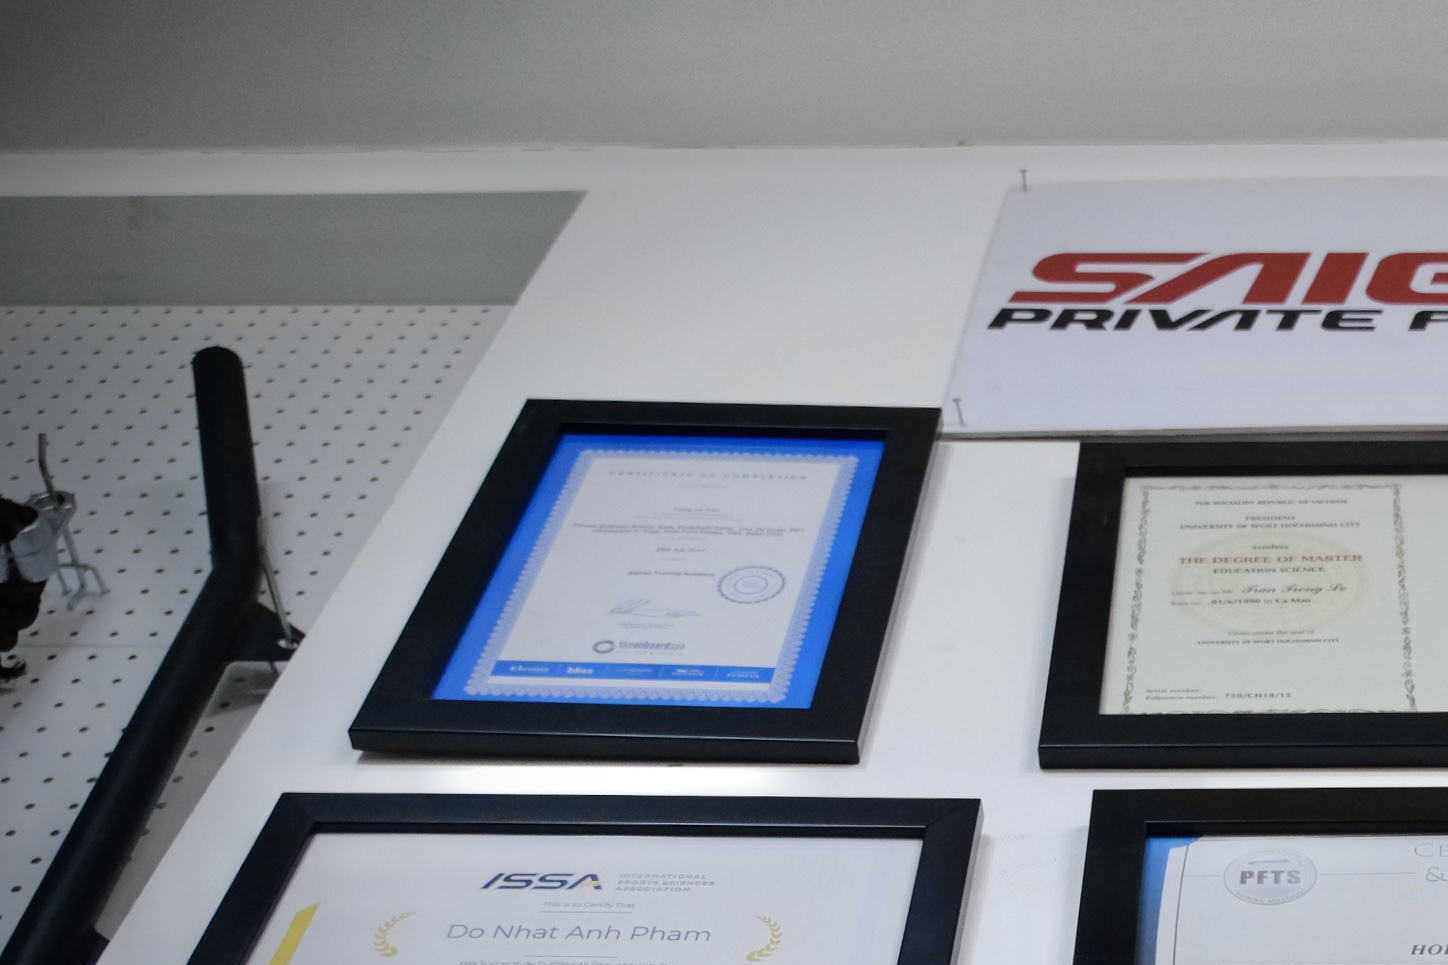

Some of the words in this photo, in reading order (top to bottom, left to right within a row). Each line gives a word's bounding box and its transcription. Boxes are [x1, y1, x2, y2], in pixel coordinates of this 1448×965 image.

[987, 308, 1382, 332] PRIVATE
[1212, 556, 1272, 564] DEGREE
[1276, 555, 1295, 563] OF
[1301, 554, 1363, 562] MASTER
[566, 666, 594, 675] bliss
[480, 872, 603, 890] ISSA
[1239, 870, 1302, 885] PFTS
[1424, 866, 1448, 883] &
[446, 924, 485, 939] Do
[492, 924, 560, 940] Nhat
[564, 925, 621, 941] Anh
[630, 925, 711, 942] Pham
